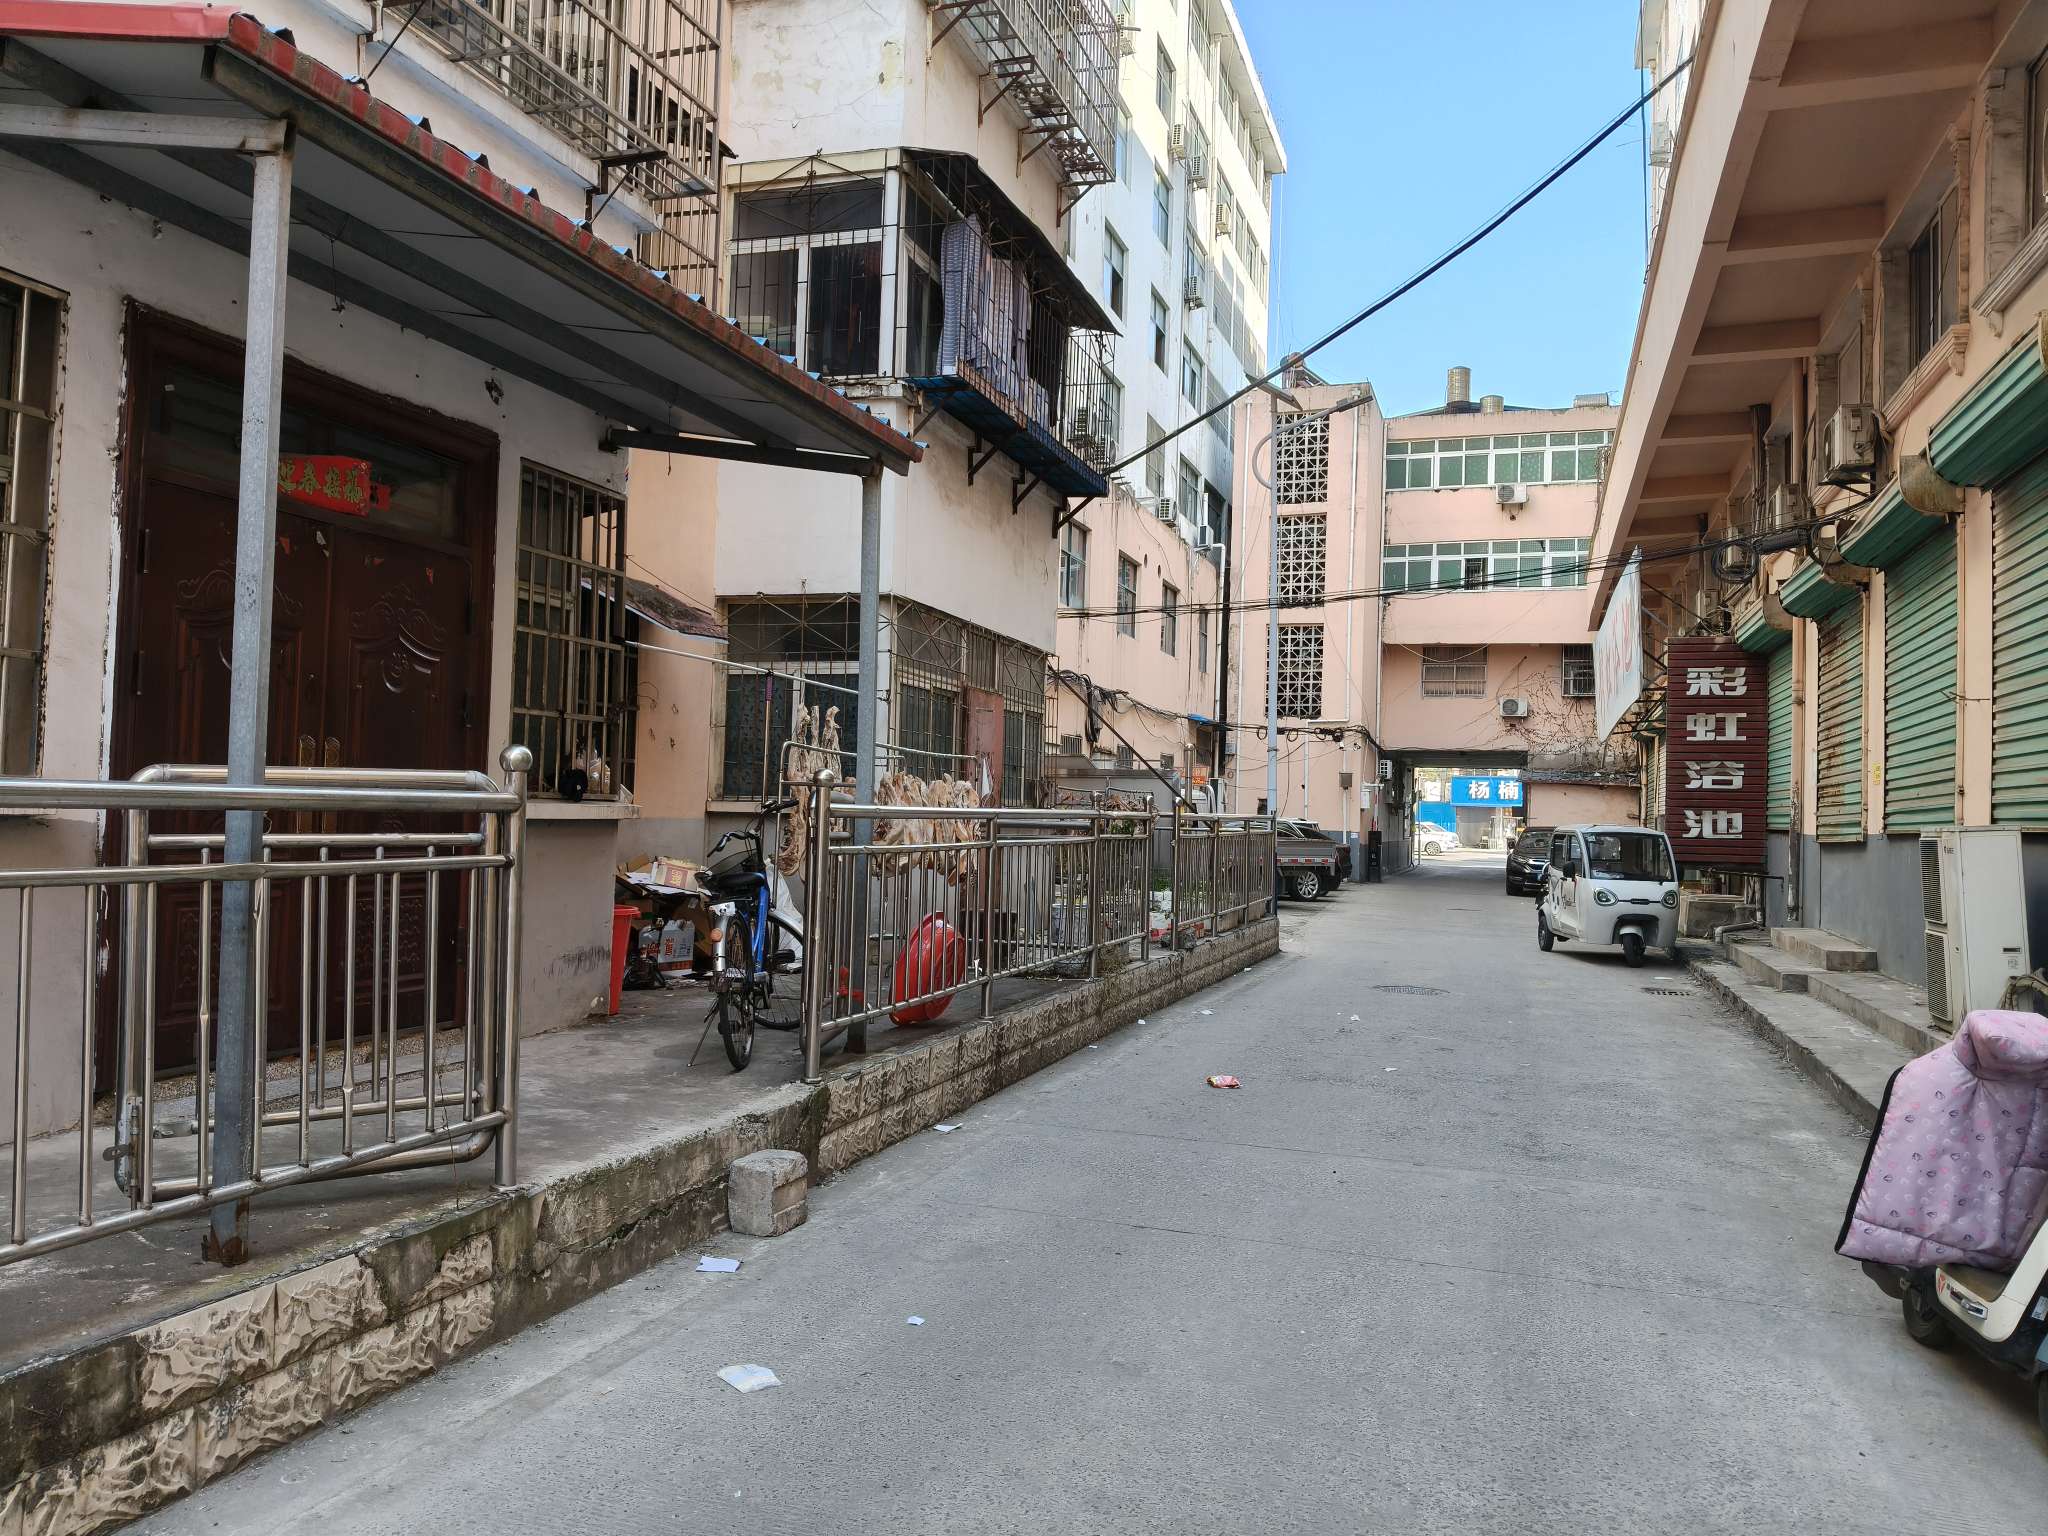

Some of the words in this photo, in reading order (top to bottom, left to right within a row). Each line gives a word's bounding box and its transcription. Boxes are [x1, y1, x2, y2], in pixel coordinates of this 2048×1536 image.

[1468, 780, 1519, 800] 杨楠
[1682, 666, 1748, 839] 彩虹浴池
